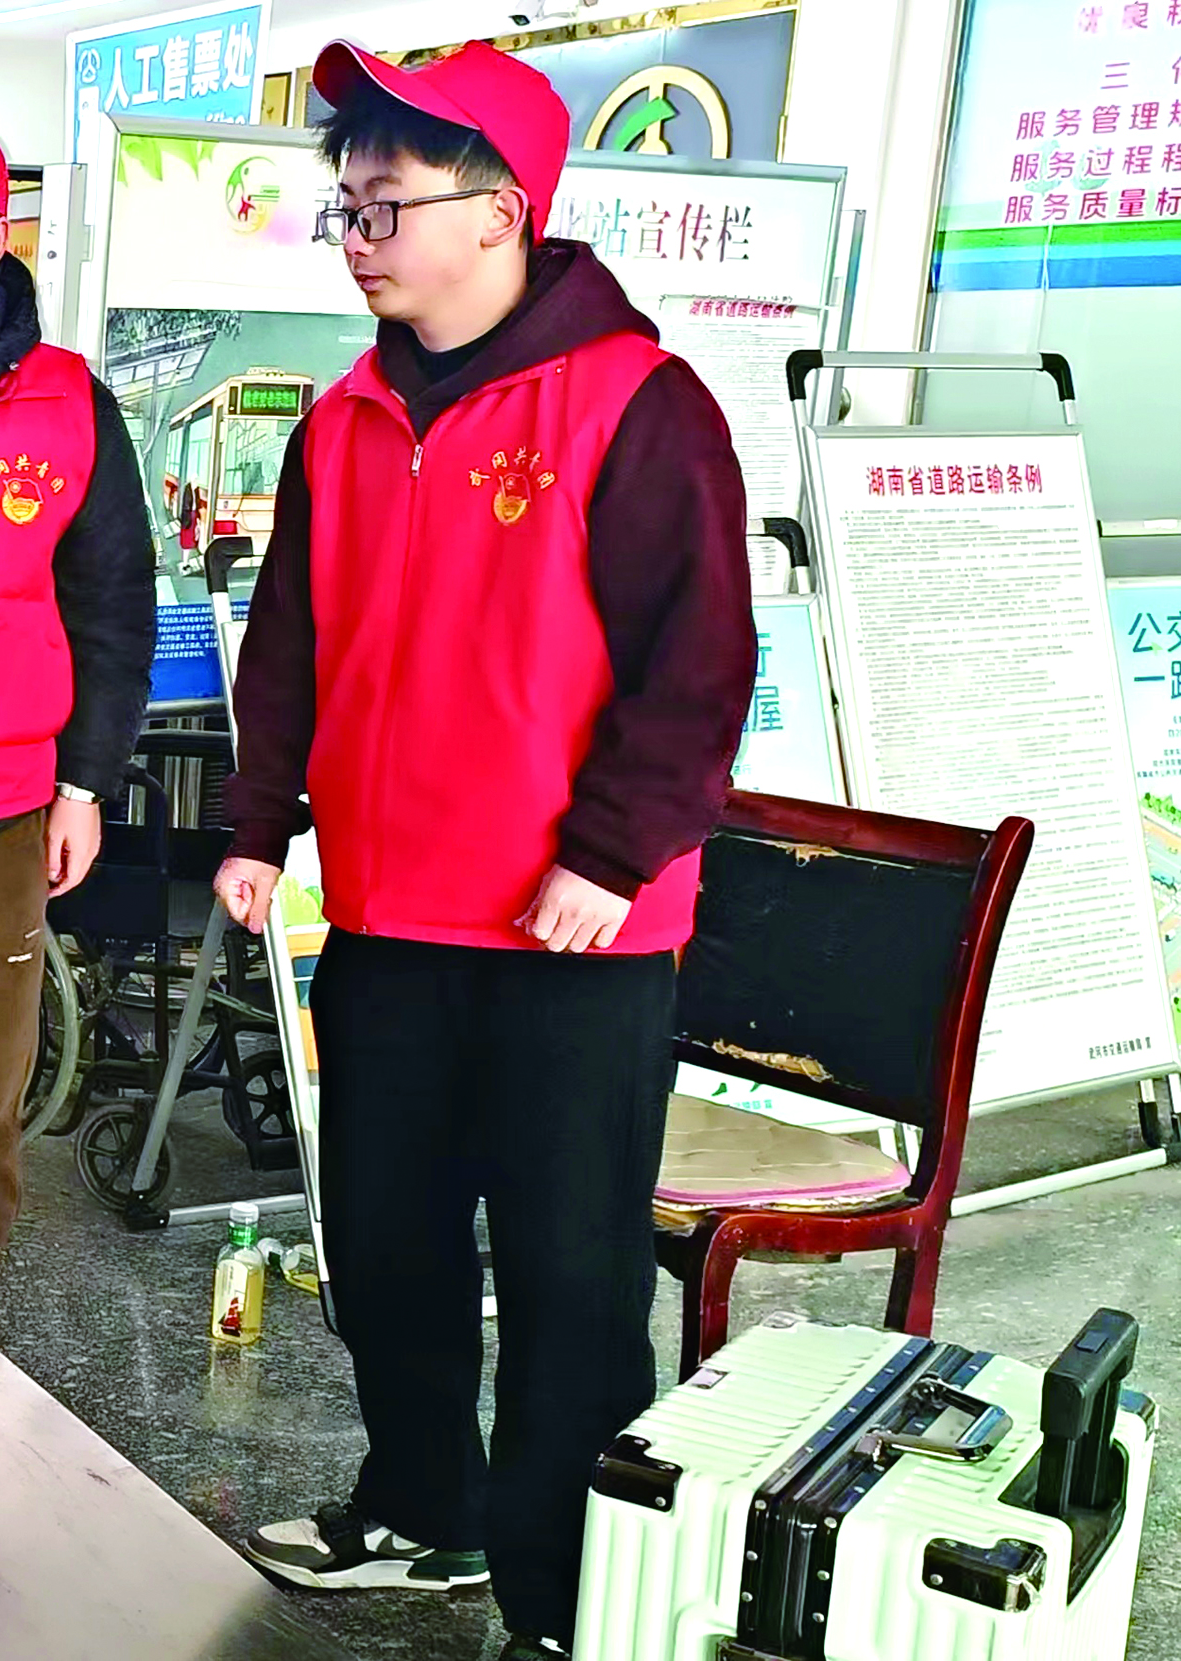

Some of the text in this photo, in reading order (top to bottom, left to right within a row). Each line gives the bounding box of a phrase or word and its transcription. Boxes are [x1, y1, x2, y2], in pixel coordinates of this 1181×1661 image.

[104, 22, 255, 113] 人工售票处
[1004, 187, 1181, 224] 服务质量标
[865, 463, 1043, 496] 湖南省道路运输条例
